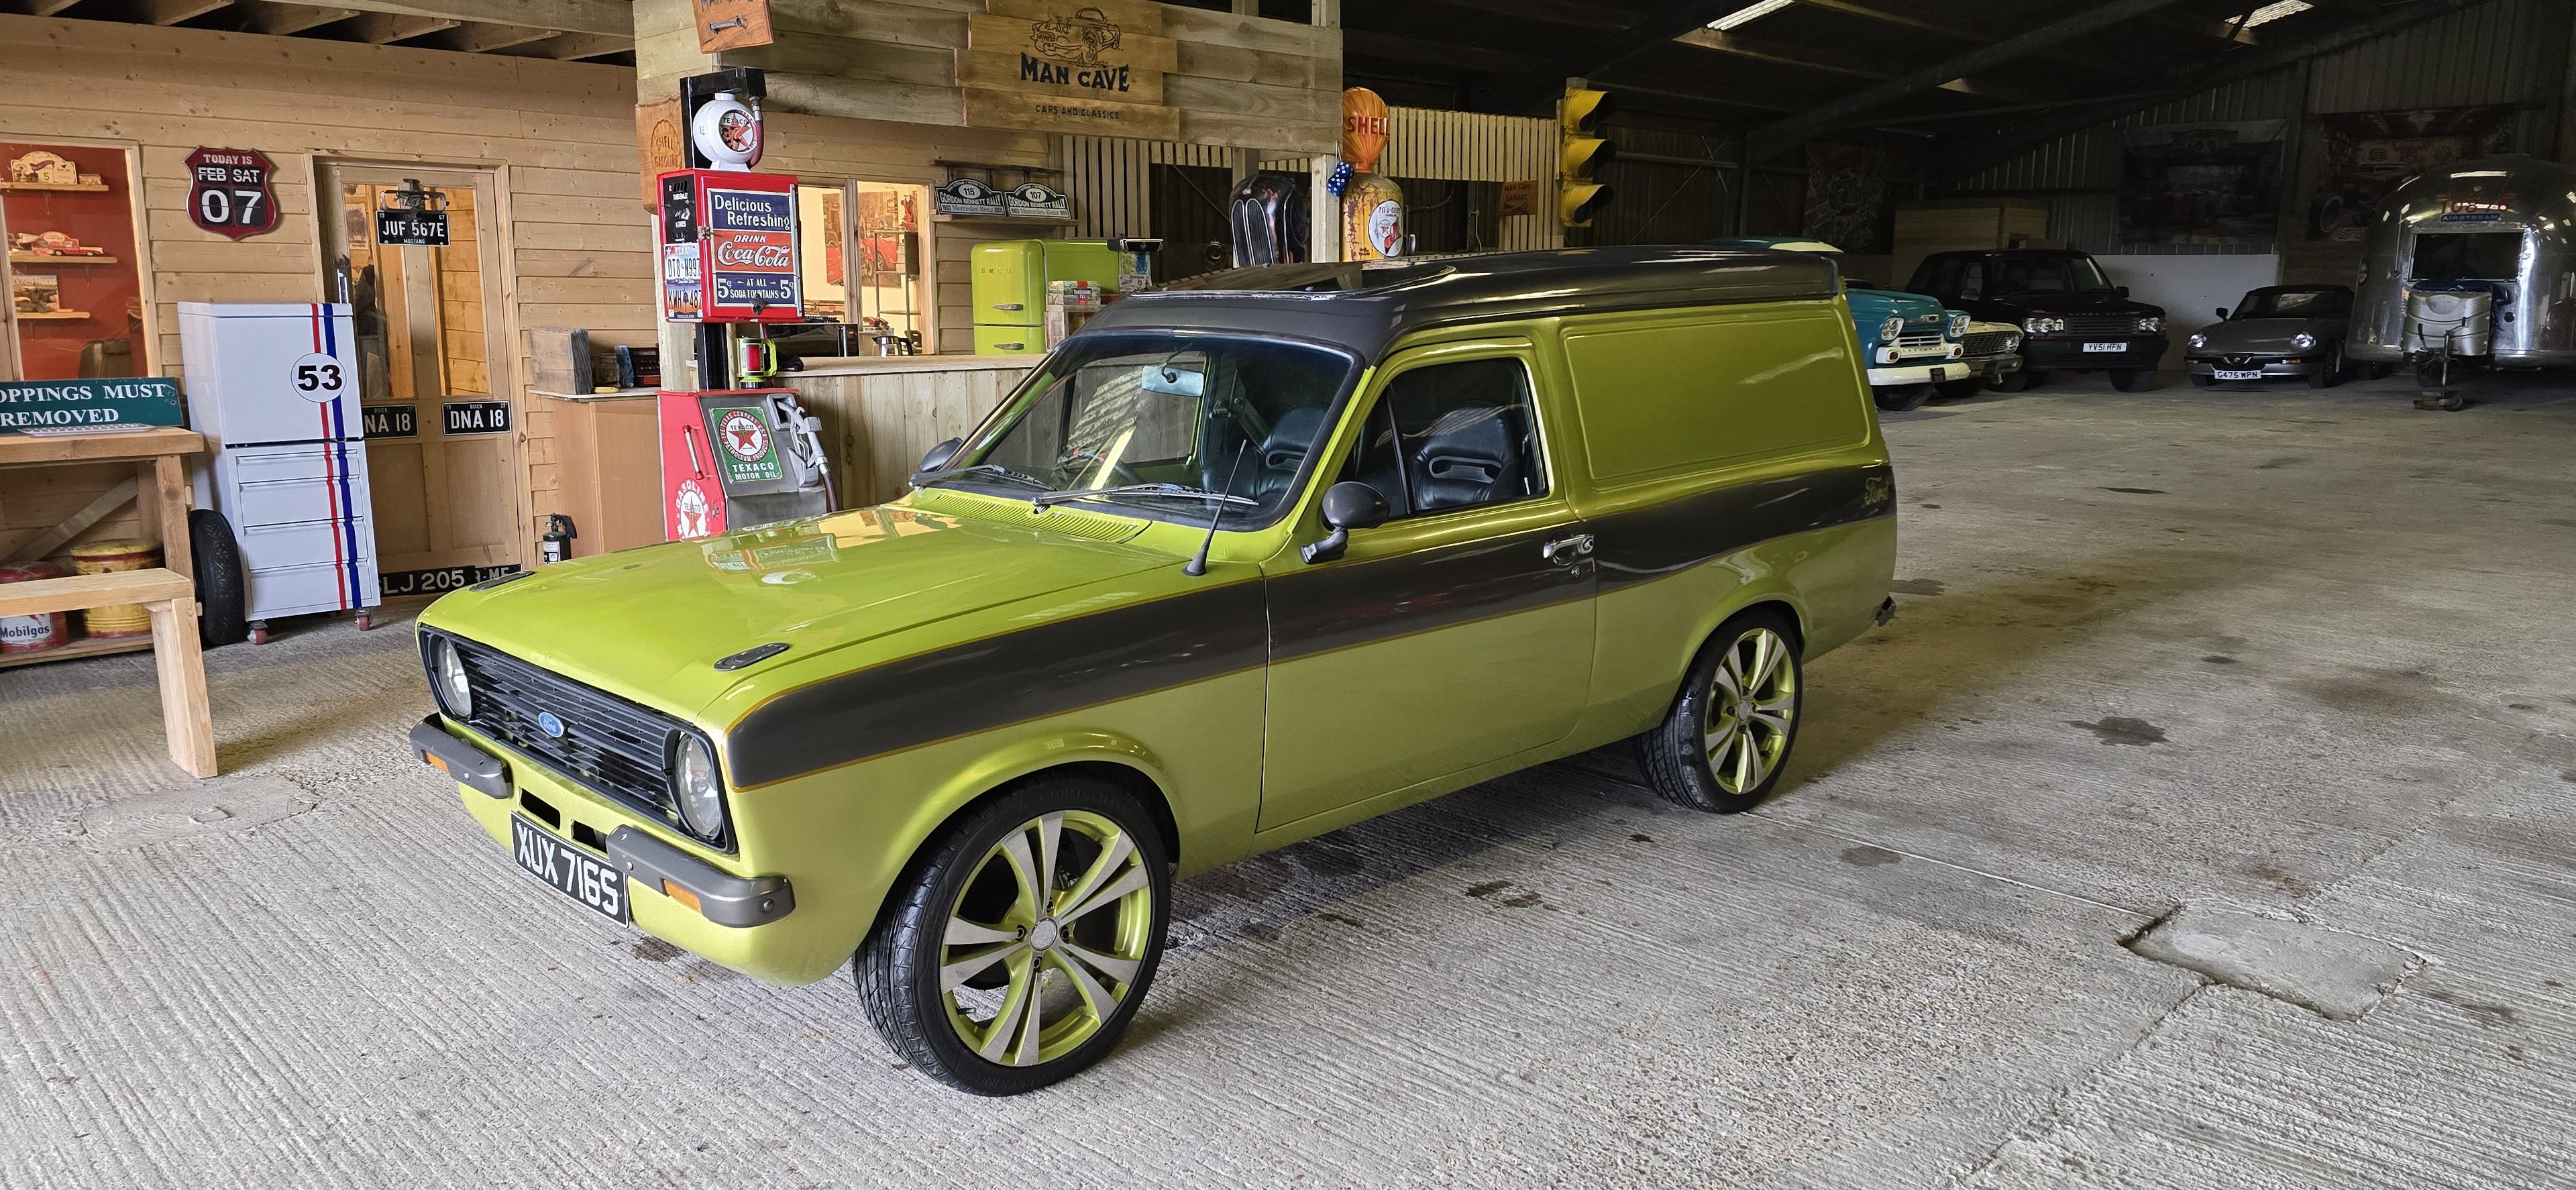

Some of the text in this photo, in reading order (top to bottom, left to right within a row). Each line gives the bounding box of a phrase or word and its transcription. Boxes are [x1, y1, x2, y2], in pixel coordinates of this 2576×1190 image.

[1020, 52, 1130, 92] MAN CAVE
[1035, 105, 1120, 119] CARS AND CLASSICS
[722, 117, 749, 126] TEXACO
[1346, 115, 1391, 136] SHELL
[655, 136, 674, 151] SHELL
[203, 154, 253, 165] TODAY IS
[44, 172, 50, 180] 5
[198, 167, 260, 182] FEB SAT
[940, 192, 963, 204] GORDON
[986, 194, 1002, 205] RALLY
[963, 187, 975, 196] 115
[1030, 191, 1041, 199] 107
[714, 195, 771, 213] Delicious
[952, 205, 994, 213] Mercedes-Benz
[1008, 196, 1030, 207] GORDON
[1052, 198, 1066, 209] RALLY
[727, 211, 790, 231] Refreshing
[382, 221, 445, 237] JUF 567E
[733, 235, 767, 244] DRINK
[717, 241, 790, 268] Coca-Cola
[746, 278, 767, 286] AT ALL
[668, 290, 682, 309] KWH
[730, 289, 747, 299] SODA
[297, 365, 343, 391] 53
[103, 384, 166, 399] MUST
[0, 408, 119, 427] REMOVED
[364, 416, 389, 433] NA
[450, 410, 484, 429] DNA
[723, 439, 769, 462] PETROLEUM PRODUCTS
[732, 462, 775, 472] TEXACO
[735, 472, 760, 480] MOTOR
[676, 480, 709, 514] GASOLINE
[380, 570, 465, 594] LJ 205
[0, 625, 50, 638] Mobilgas
[516, 821, 619, 916] XUX 716S
